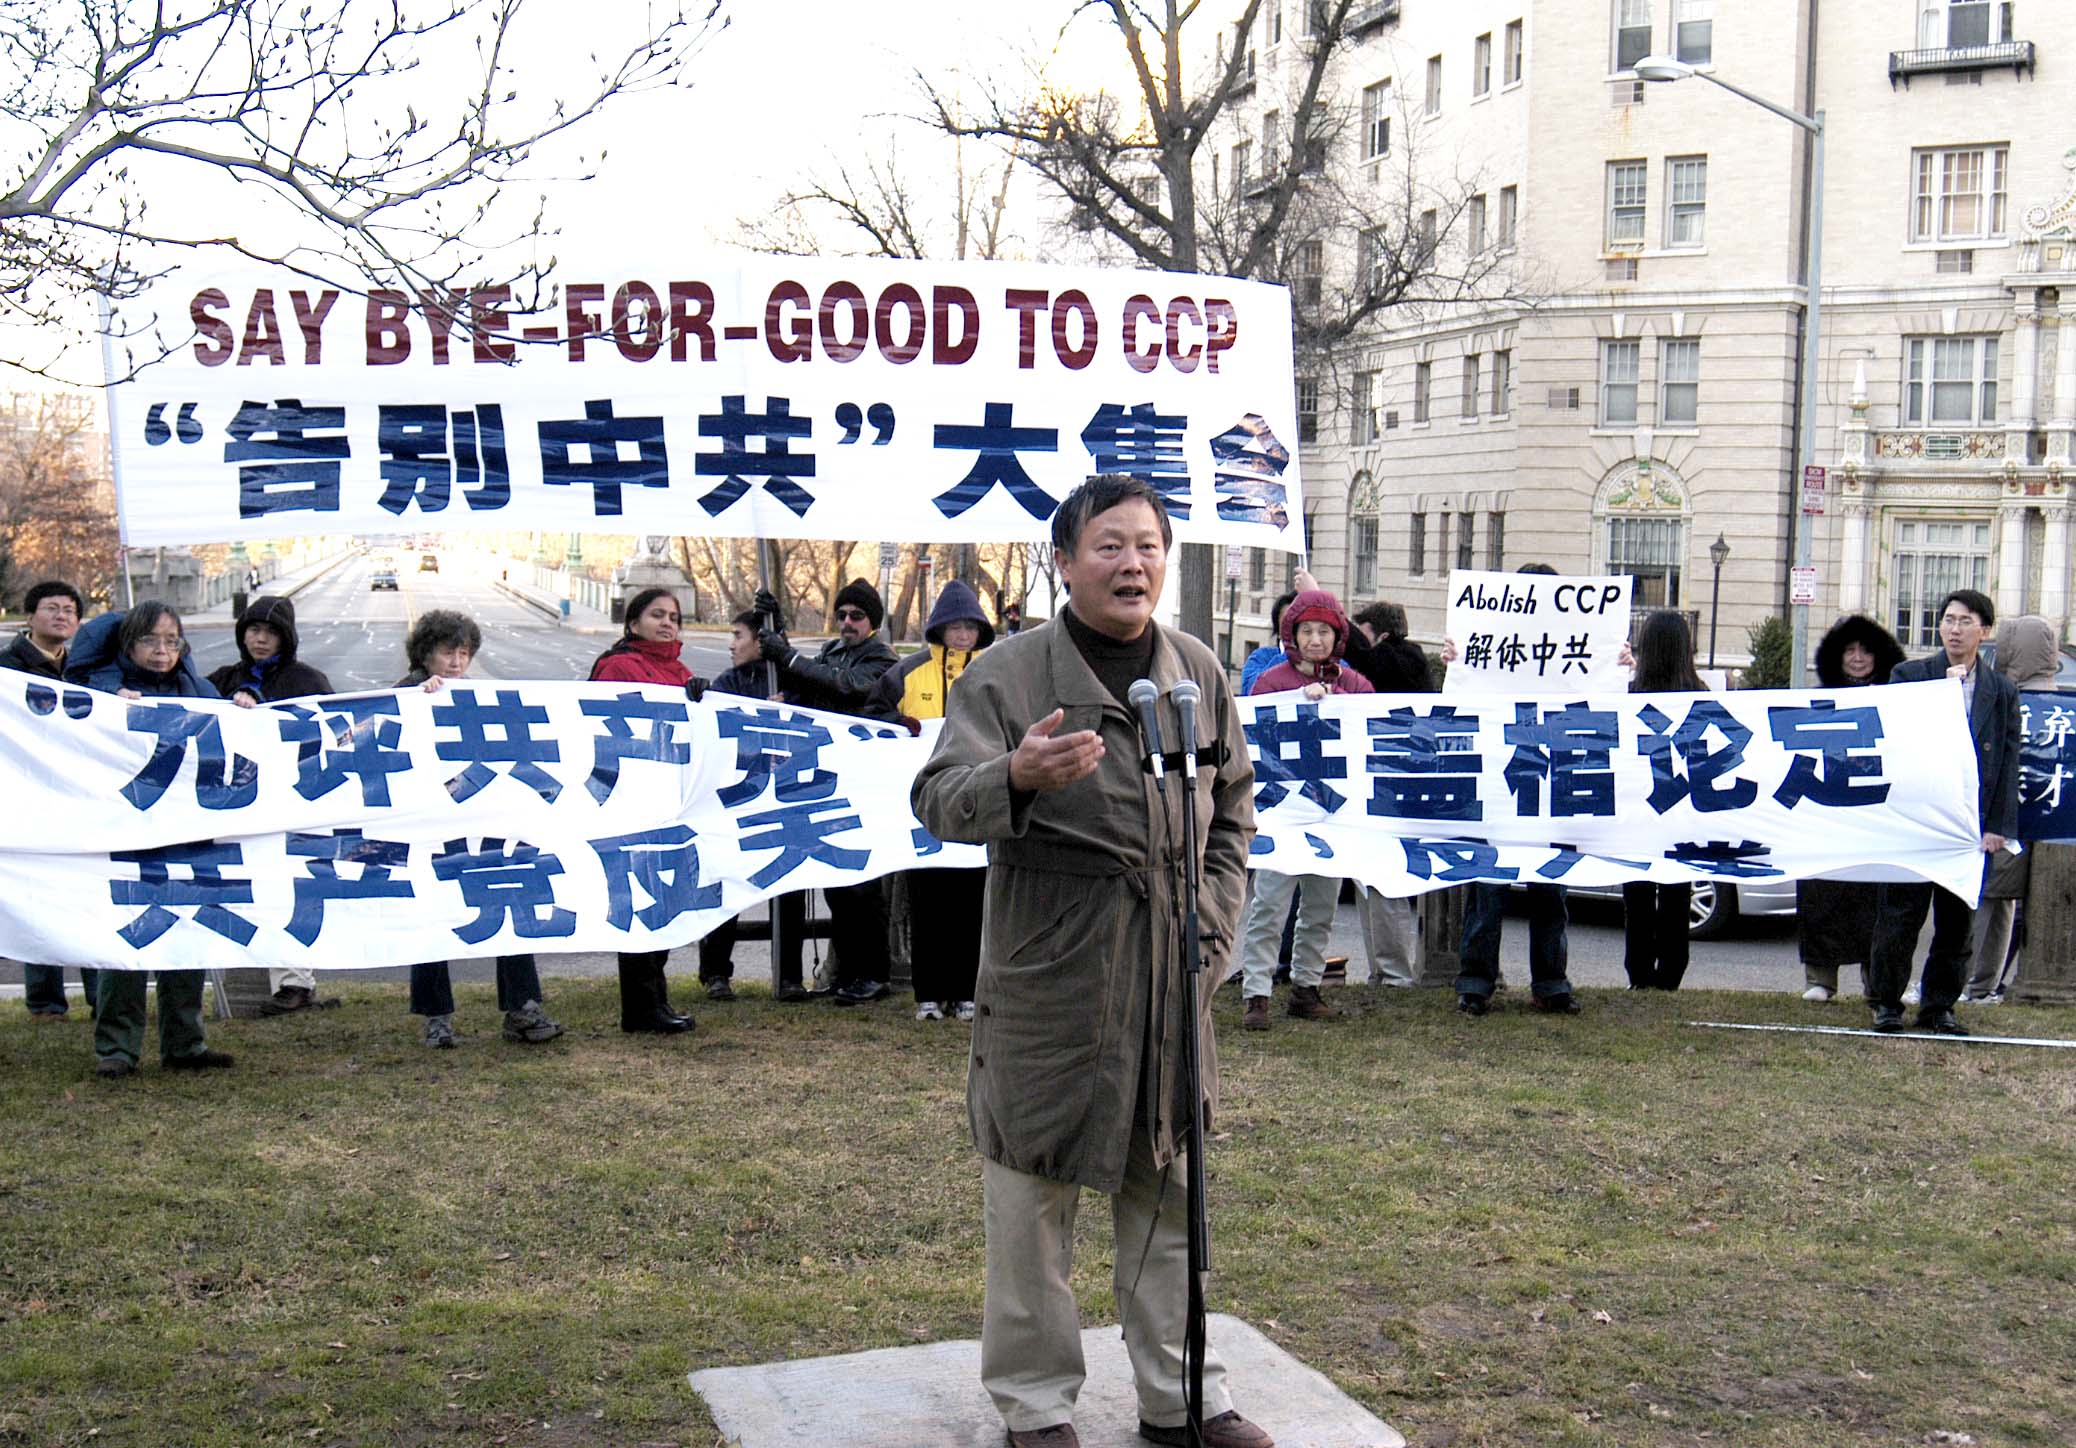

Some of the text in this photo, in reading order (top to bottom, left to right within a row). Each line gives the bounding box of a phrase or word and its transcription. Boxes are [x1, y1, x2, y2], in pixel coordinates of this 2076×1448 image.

[190, 280, 1237, 374] SAY BYE-FOR-GOOD TO CCP
[880, 556, 895, 566] 25
[1456, 583, 1621, 615] Abolish CCP
[1464, 632, 1592, 676] 解体中共
